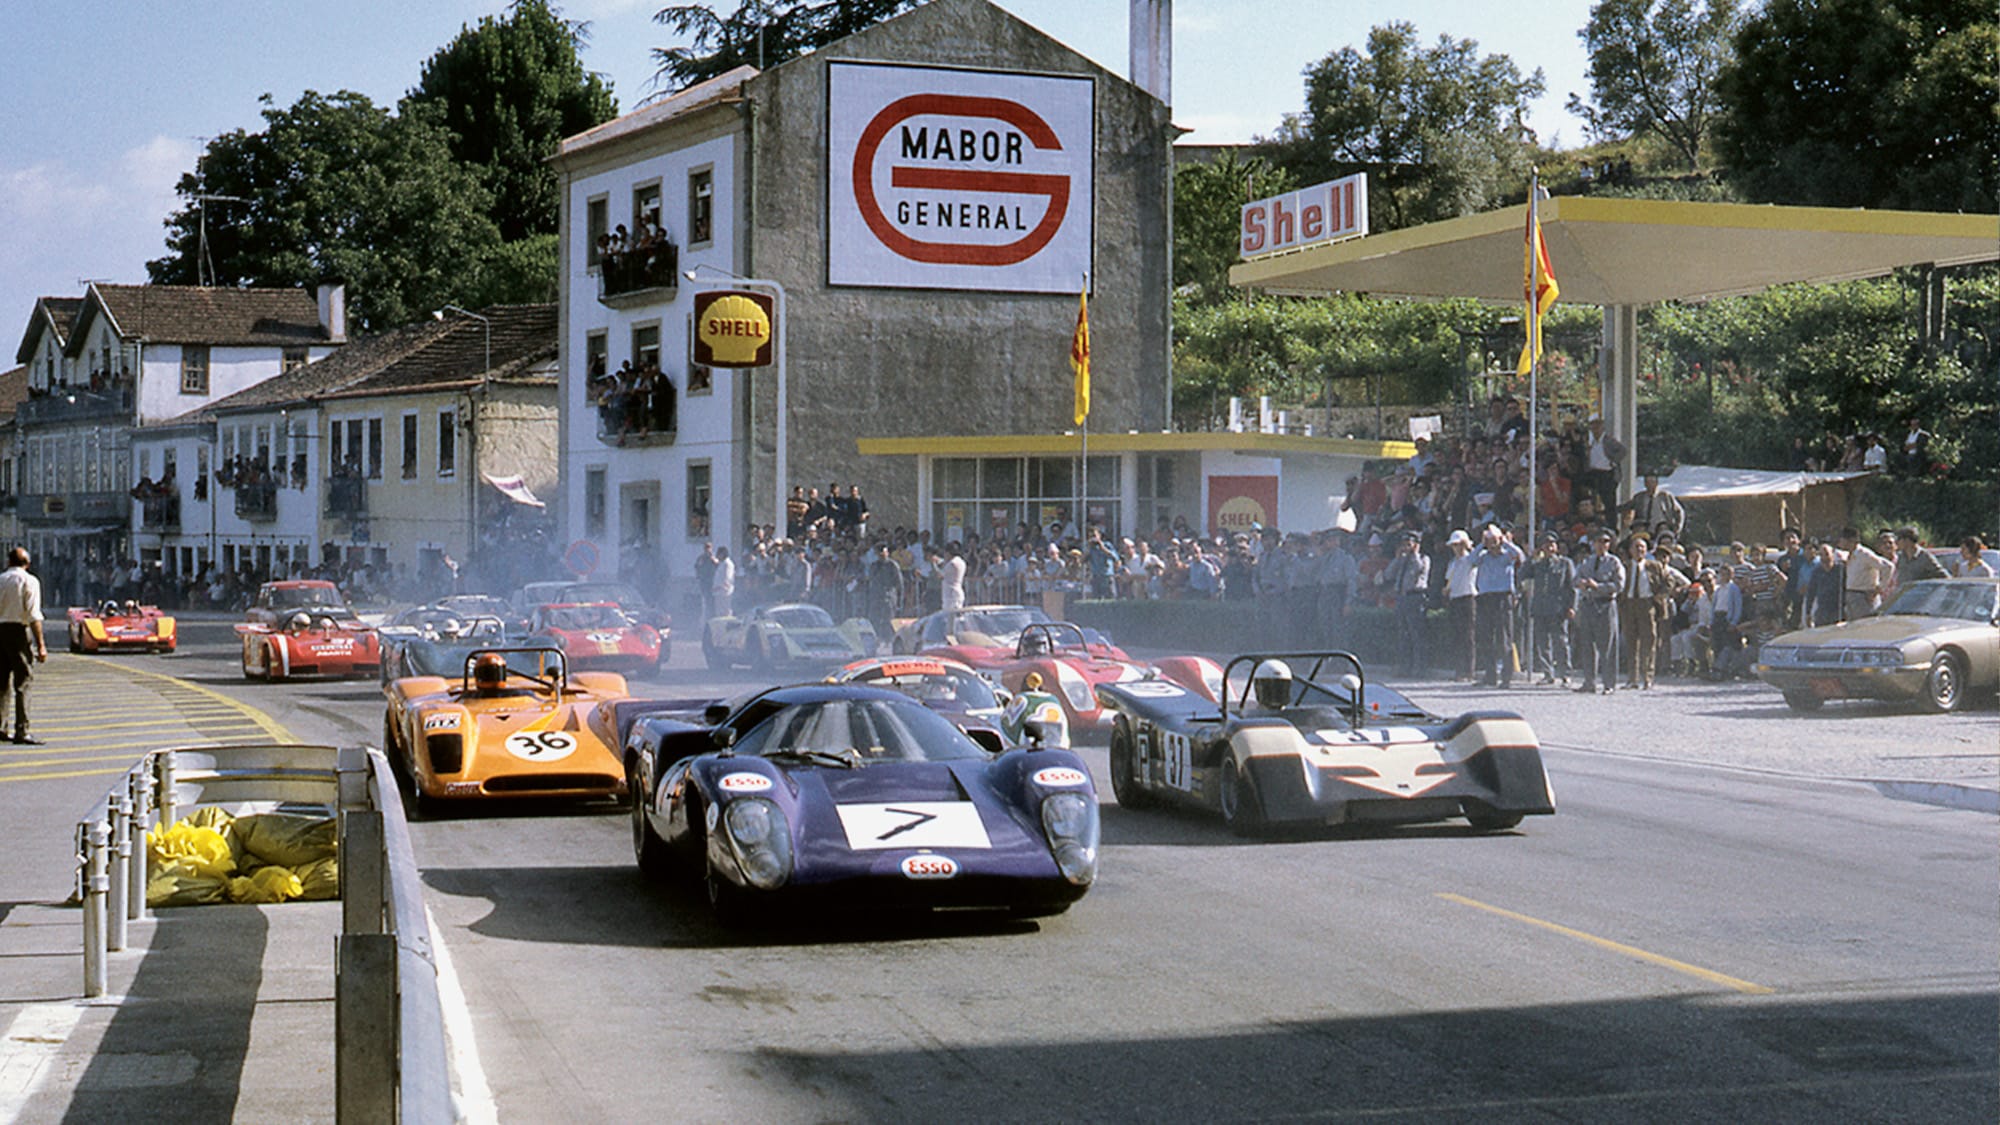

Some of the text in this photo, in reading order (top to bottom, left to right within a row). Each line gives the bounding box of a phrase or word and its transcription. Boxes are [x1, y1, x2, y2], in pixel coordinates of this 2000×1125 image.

[901, 125, 1023, 165] MABOR
[897, 200, 1027, 231] GENERAL
[1243, 181, 1355, 252] Shell
[708, 319, 764, 338] SHELL
[514, 731, 570, 756] 36
[876, 807, 938, 840] 7
